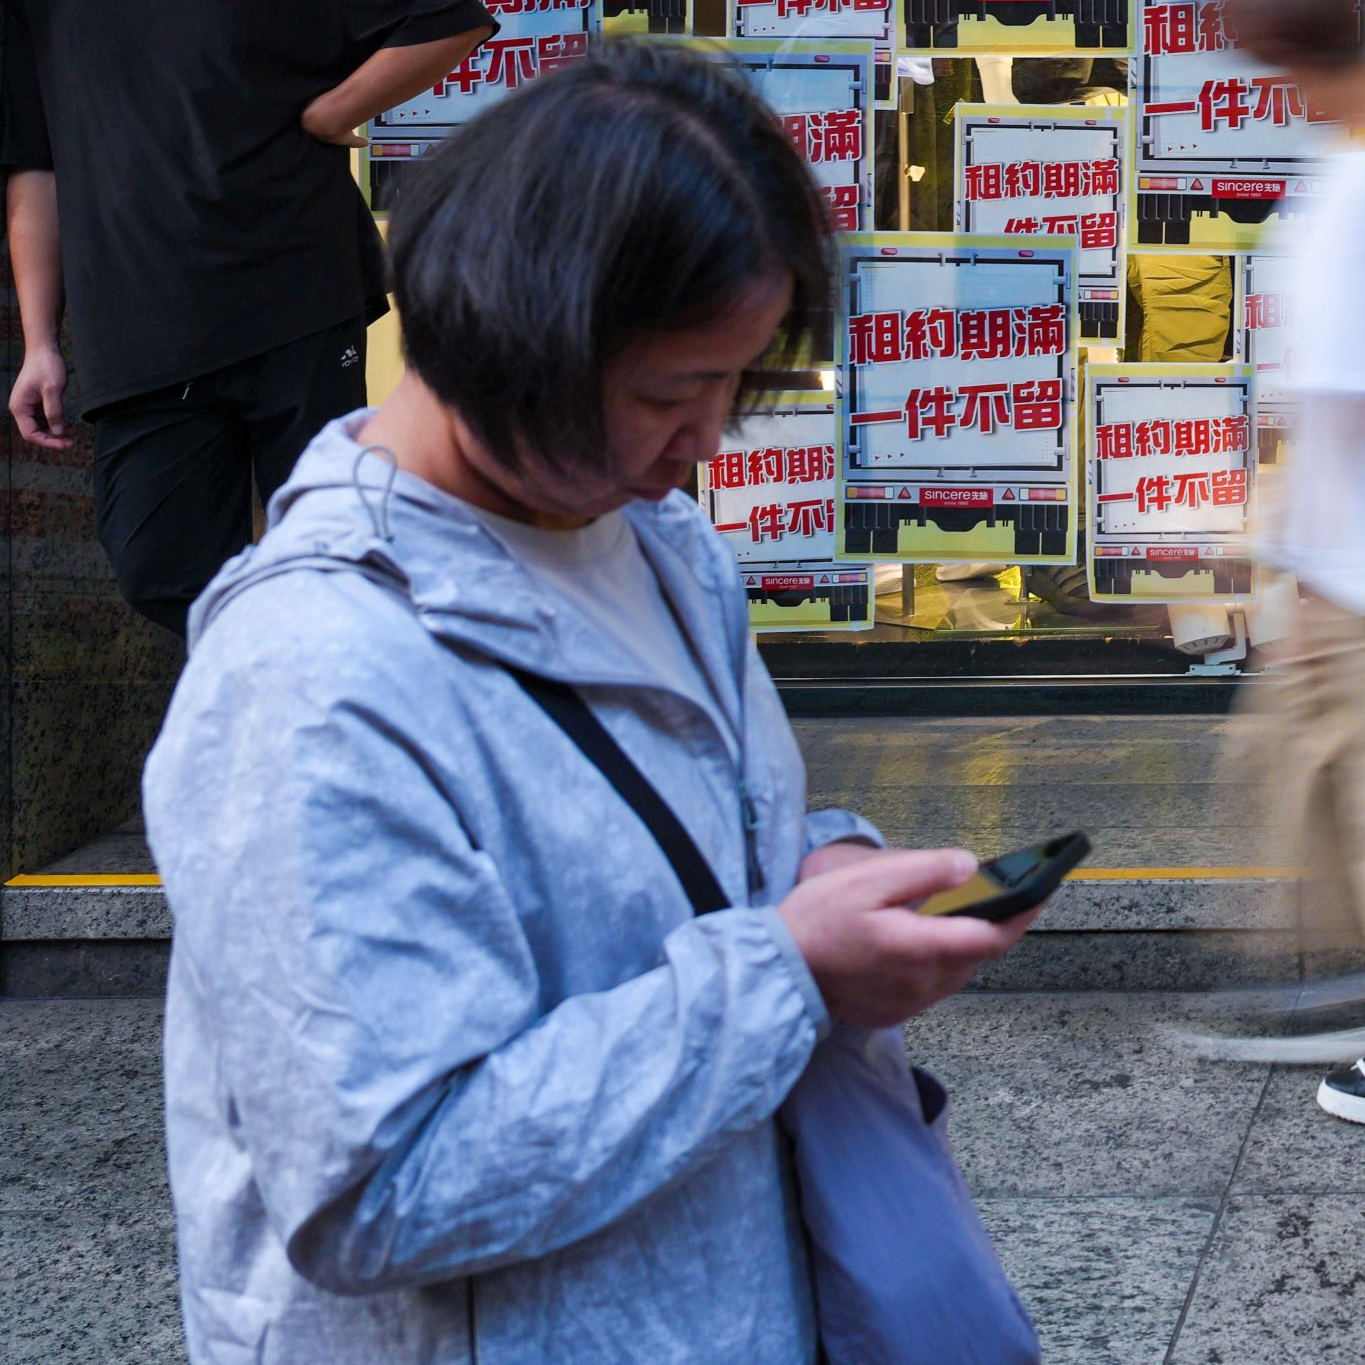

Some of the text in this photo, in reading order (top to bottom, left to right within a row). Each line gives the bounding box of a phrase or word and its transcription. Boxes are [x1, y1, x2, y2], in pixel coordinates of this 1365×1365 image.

[963, 158, 1120, 202] 租約期滿
[848, 304, 1068, 367] 租約期滿
[849, 378, 1064, 442] 一件不留
[1095, 415, 1250, 462] 租約期滿
[1097, 468, 1248, 514] 一件不留
